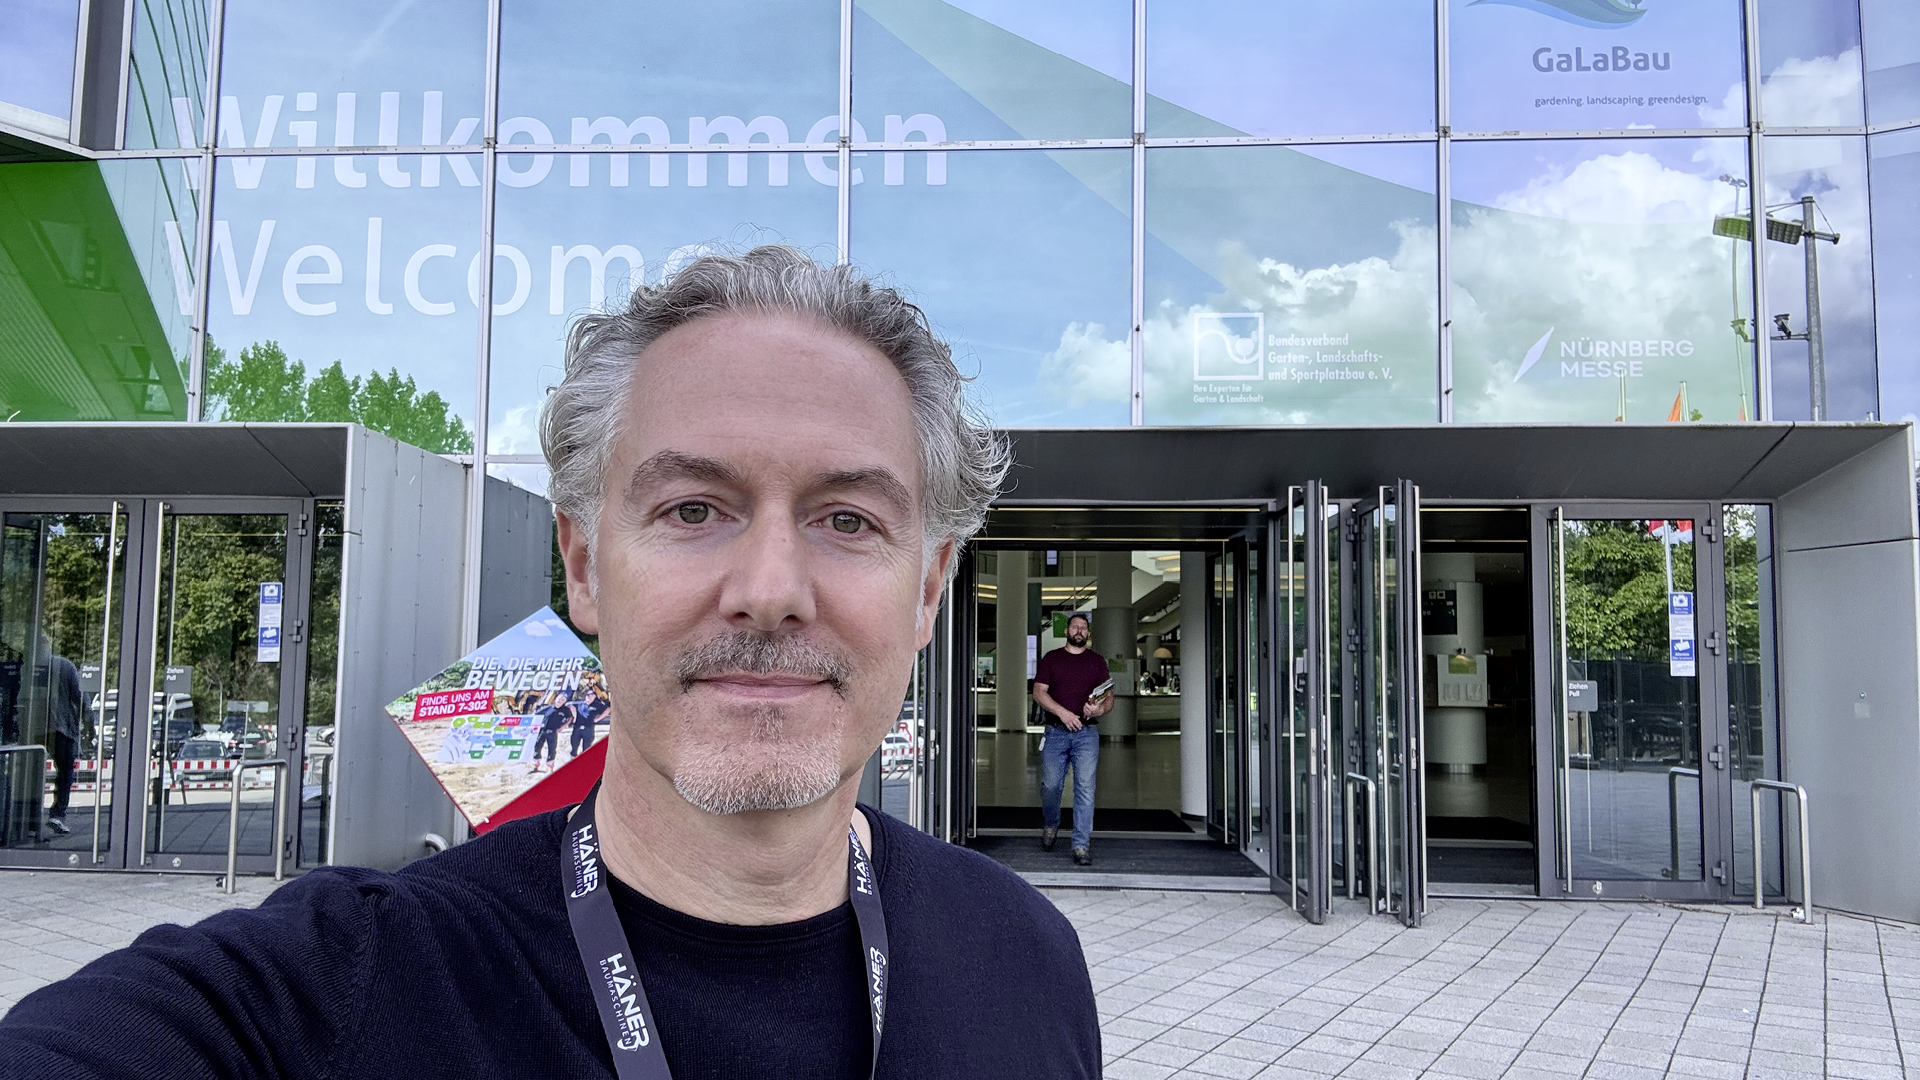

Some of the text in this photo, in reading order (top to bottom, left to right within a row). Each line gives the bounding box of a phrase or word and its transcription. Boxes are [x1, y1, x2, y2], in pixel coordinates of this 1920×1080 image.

[1532, 46, 1671, 73] GaLaBau
[1534, 94, 1709, 108] gardening. landscaping. greendesign.
[171, 90, 948, 190] Willkommen
[164, 216, 714, 316] Welcom
[1268, 333, 1349, 347] Bundesverband
[1560, 336, 1695, 358] NÜRNBERG
[1268, 349, 1384, 366] Garten-, Landschafts-
[1268, 367, 1393, 384] und Sportplatzbau e. V.
[1560, 360, 1644, 378] MESSE
[1193, 384, 1208, 393] Ihre
[1209, 384, 1241, 395] Experten
[1193, 394, 1218, 404] Garten
[1226, 394, 1264, 404] Landschaft
[472, 656, 585, 672] DIE, DIE MEHR
[464, 670, 582, 692] BEWEGEN
[1568, 682, 1589, 690] Ziehen
[421, 690, 491, 707] FINDE UNS AM
[419, 700, 488, 717] STAND 7-302
[570, 824, 599, 898] HÄNER
[599, 959, 633, 1045] BAUMASCHINEN
[607, 952, 650, 1052] HÄNER
